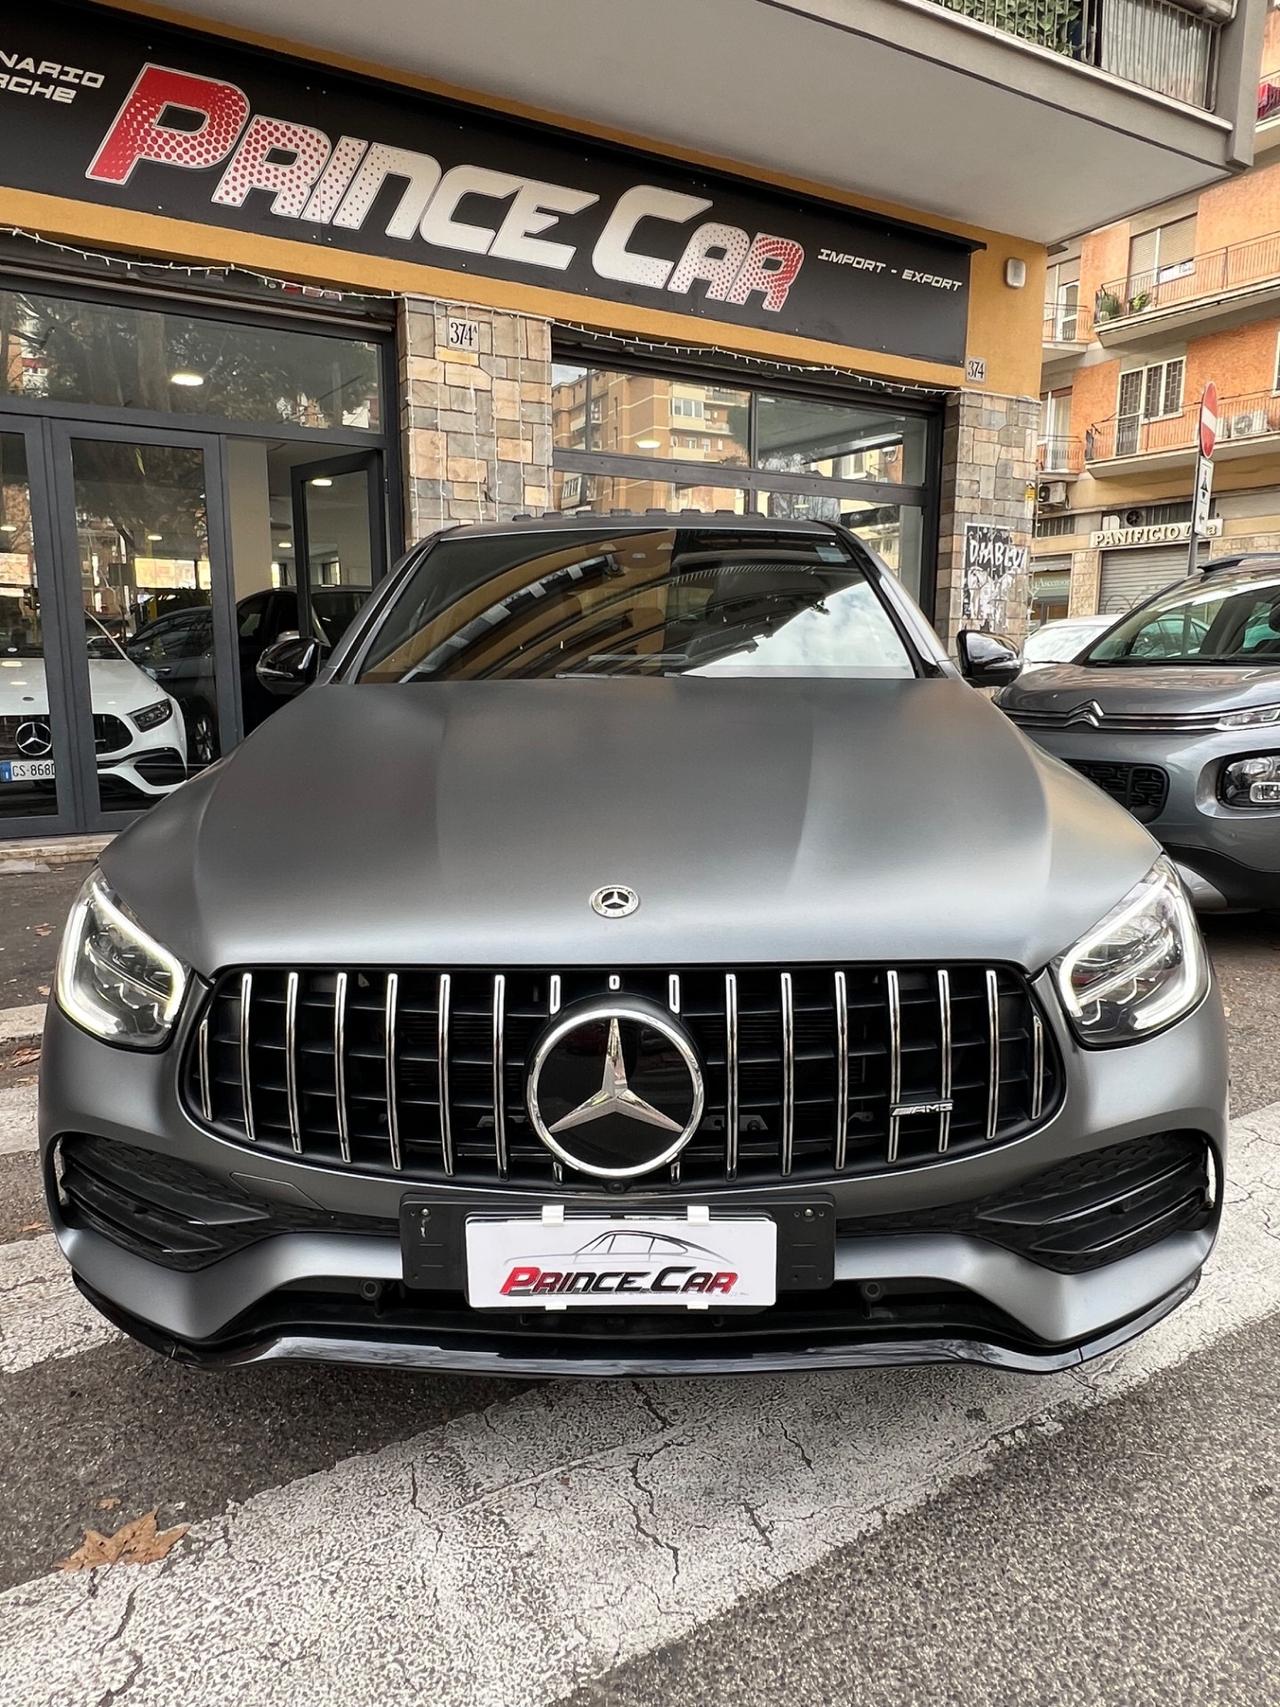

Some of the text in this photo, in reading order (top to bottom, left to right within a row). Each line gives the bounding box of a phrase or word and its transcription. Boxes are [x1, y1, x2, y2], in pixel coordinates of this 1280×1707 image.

[85, 62, 805, 312] PRINCE CAR
[817, 248, 887, 273] IMPORT
[901, 268, 963, 291] EXPORT
[968, 360, 984, 379] 374
[1095, 525, 1181, 546] PANIFICIO
[907, 1102, 953, 1115] AMG
[500, 1265, 740, 1296] PRINCE CAR
